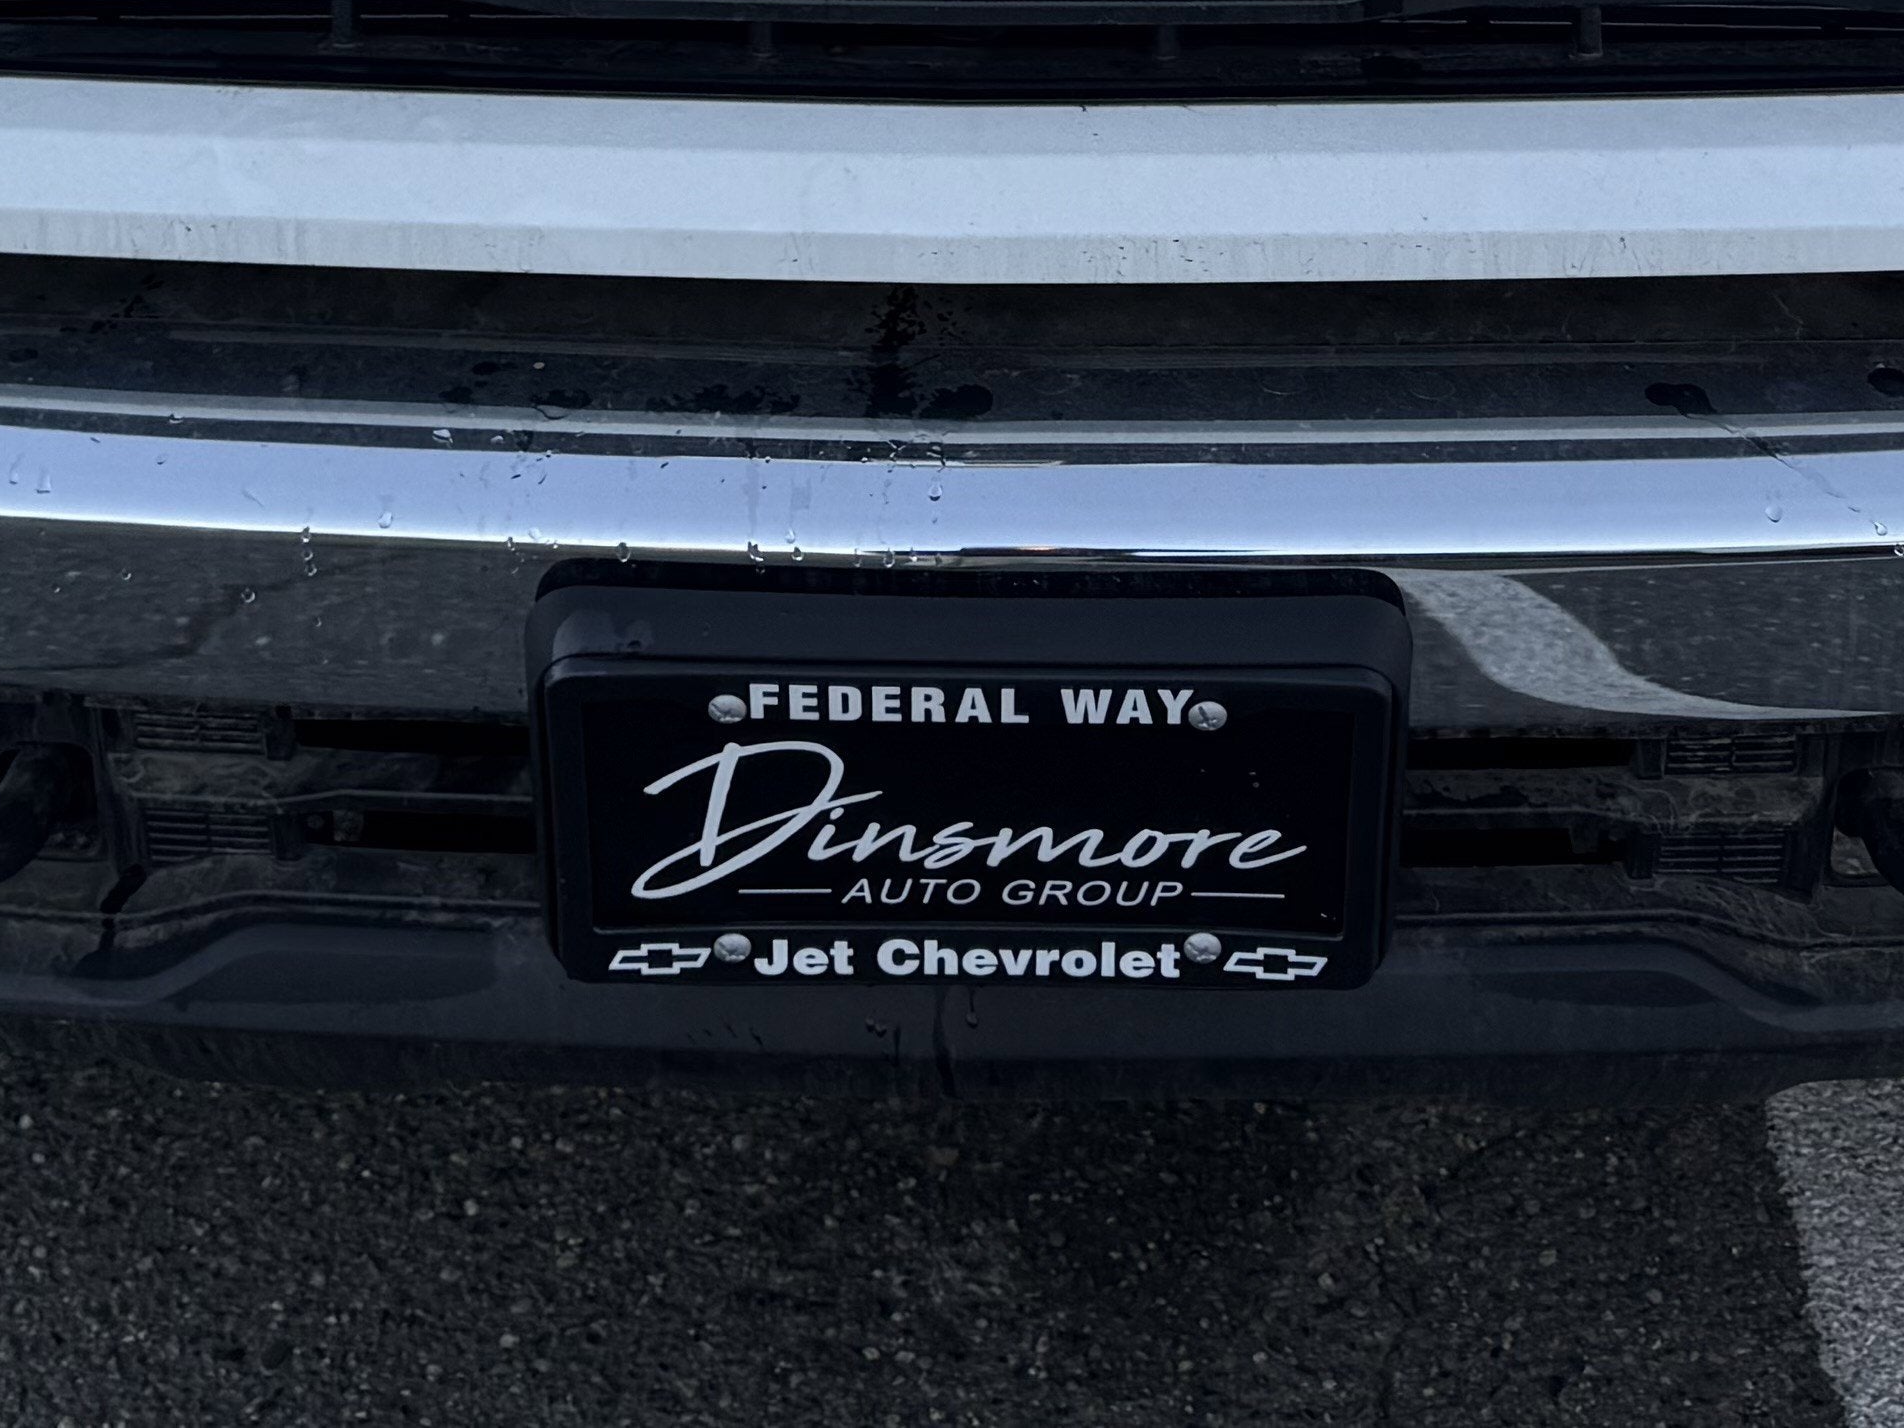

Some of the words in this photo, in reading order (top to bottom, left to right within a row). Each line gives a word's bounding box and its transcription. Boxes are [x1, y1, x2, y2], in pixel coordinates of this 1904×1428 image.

[749, 683, 1030, 724] FEDERAL
[1060, 688, 1195, 725] WAY
[630, 740, 1308, 900] Dinsmore
[841, 878, 981, 905] AUTO
[1001, 879, 1184, 907] GROUP
[753, 938, 854, 976] Jet
[876, 938, 1181, 979] Chevrolet
